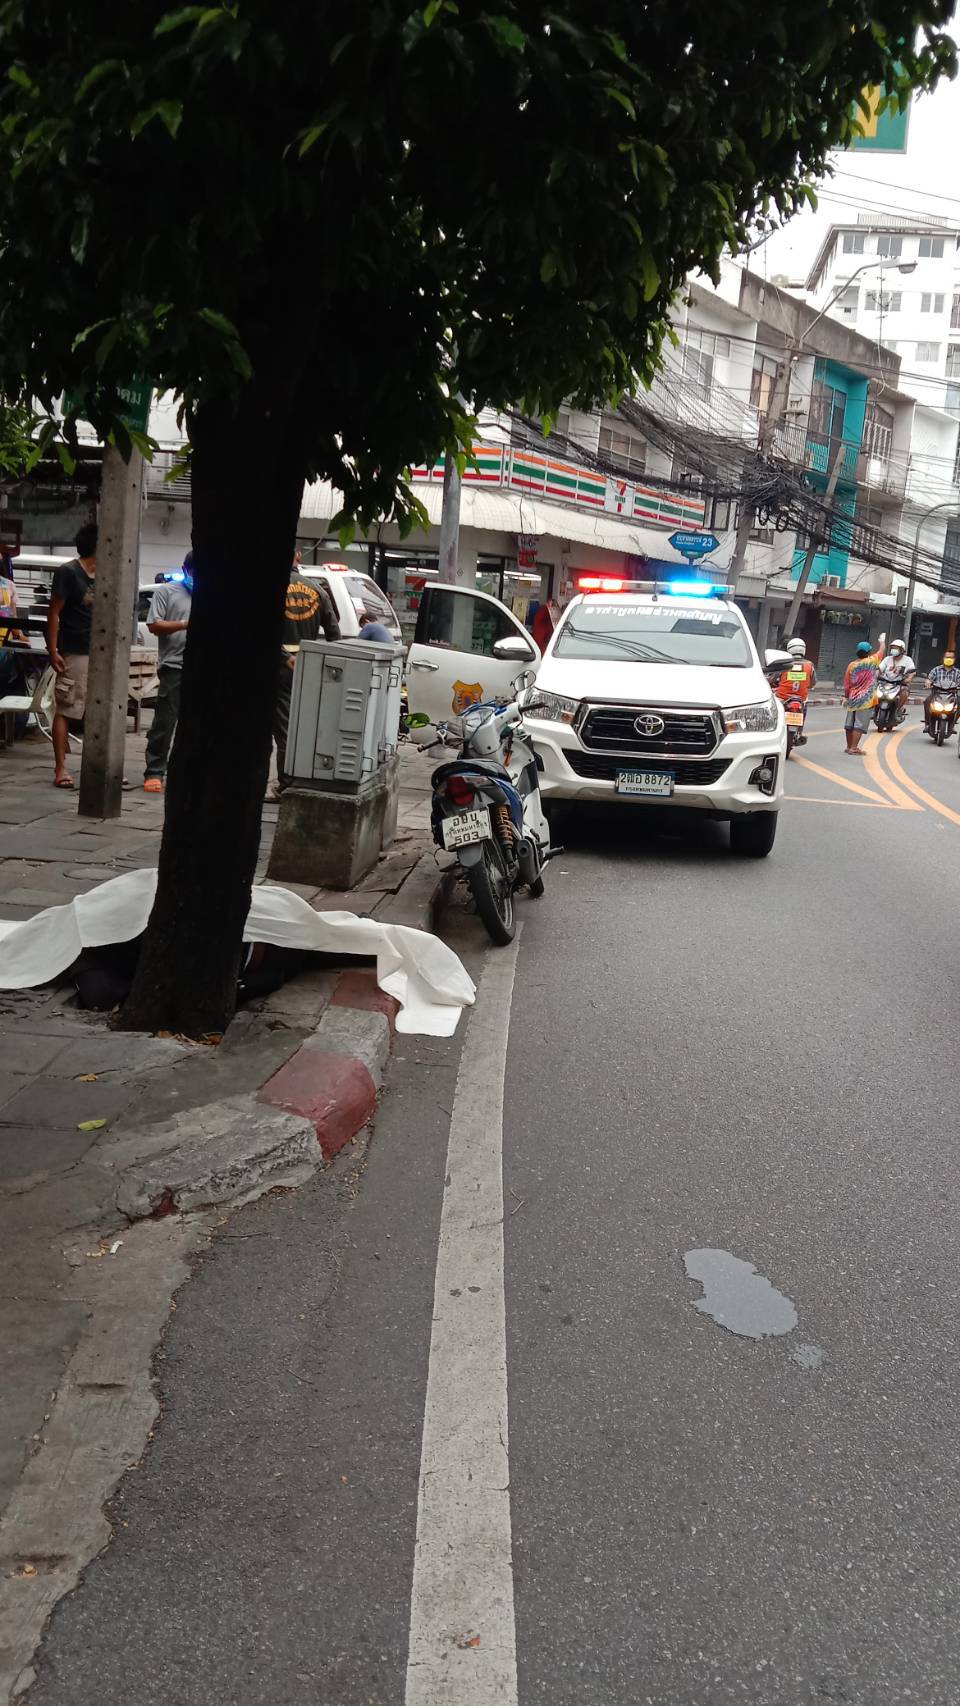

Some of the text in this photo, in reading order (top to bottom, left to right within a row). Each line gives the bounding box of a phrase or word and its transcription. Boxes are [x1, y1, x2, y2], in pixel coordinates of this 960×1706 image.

[702, 537, 713, 547] 23
[644, 774, 671, 786] 8872
[454, 831, 480, 844] 503
